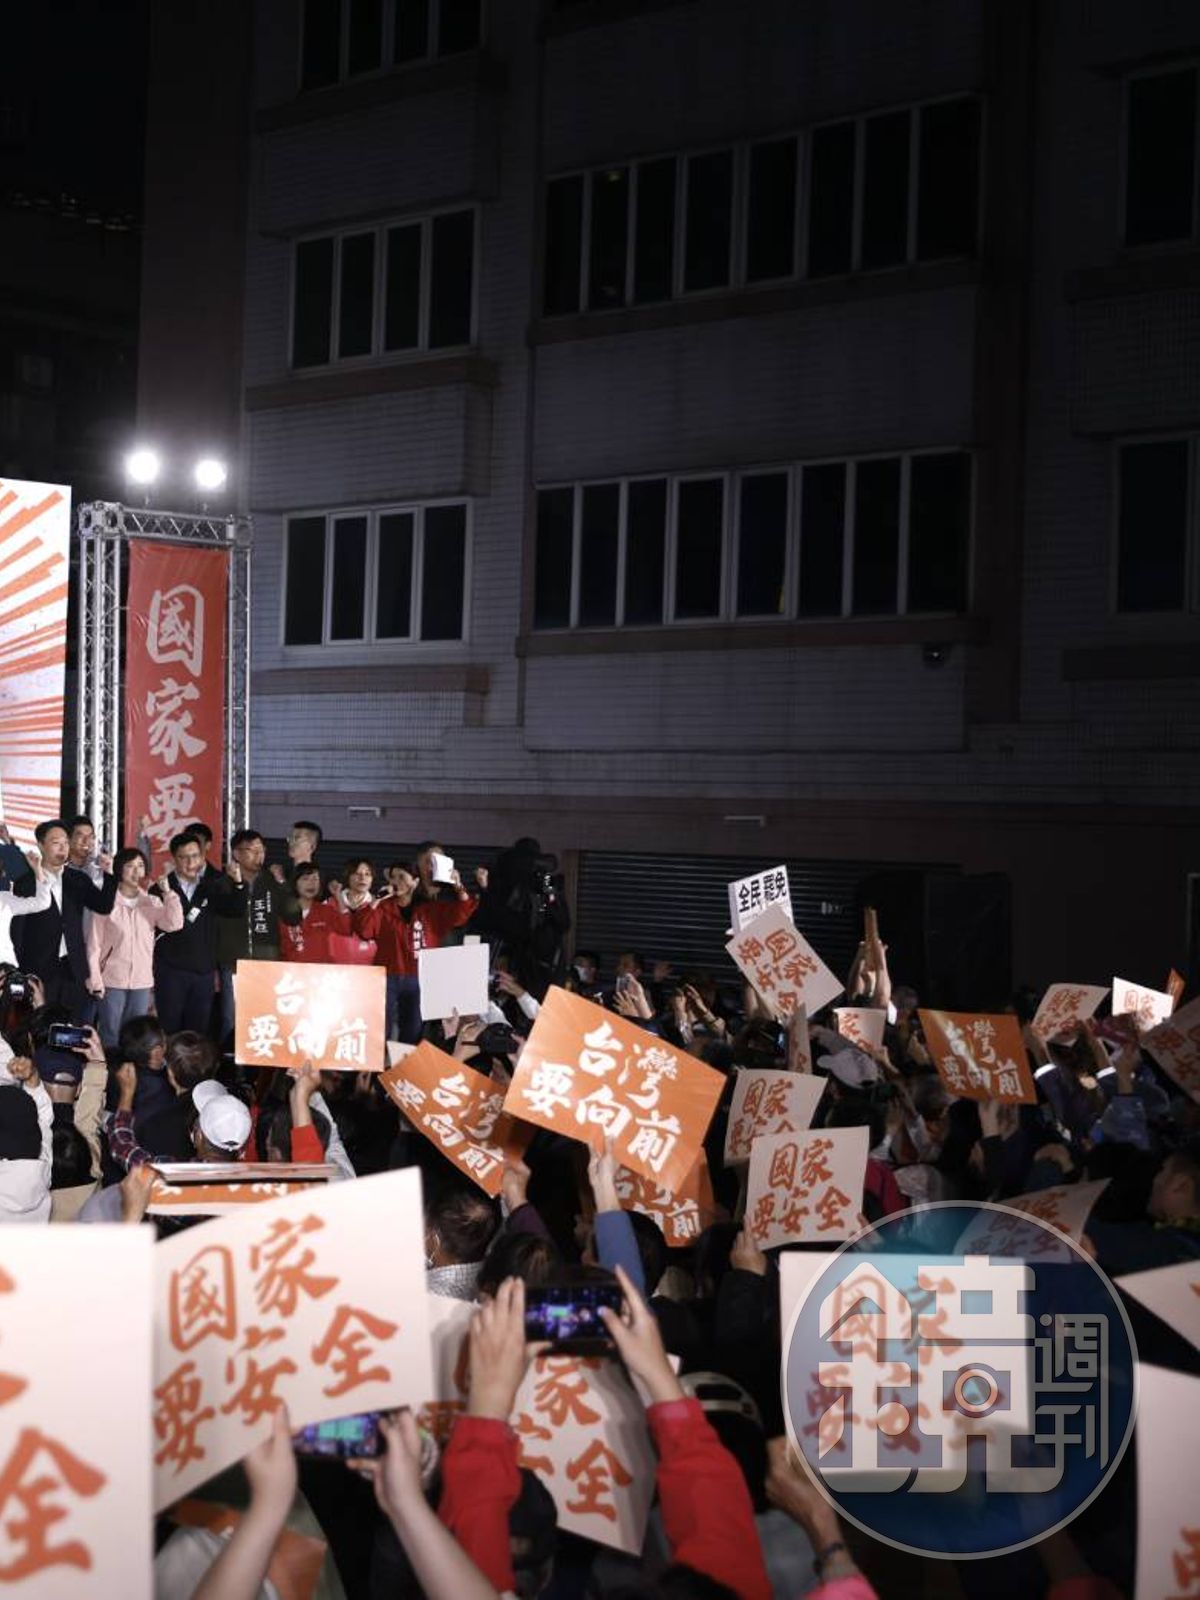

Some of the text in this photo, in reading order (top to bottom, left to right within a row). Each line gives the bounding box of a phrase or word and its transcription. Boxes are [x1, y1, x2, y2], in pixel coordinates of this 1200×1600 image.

[141, 584, 207, 853] 國家要
[246, 1014, 367, 1064] 要向前
[579, 1023, 678, 1110] 台灣
[389, 1077, 503, 1180] 要向前
[522, 1060, 682, 1173] 要向前
[743, 1078, 794, 1119] 國家
[752, 1185, 852, 1240] 要安全
[768, 1138, 835, 1192] 國家
[169, 1213, 340, 1352] 國家
[153, 1304, 400, 1476] 要安全
